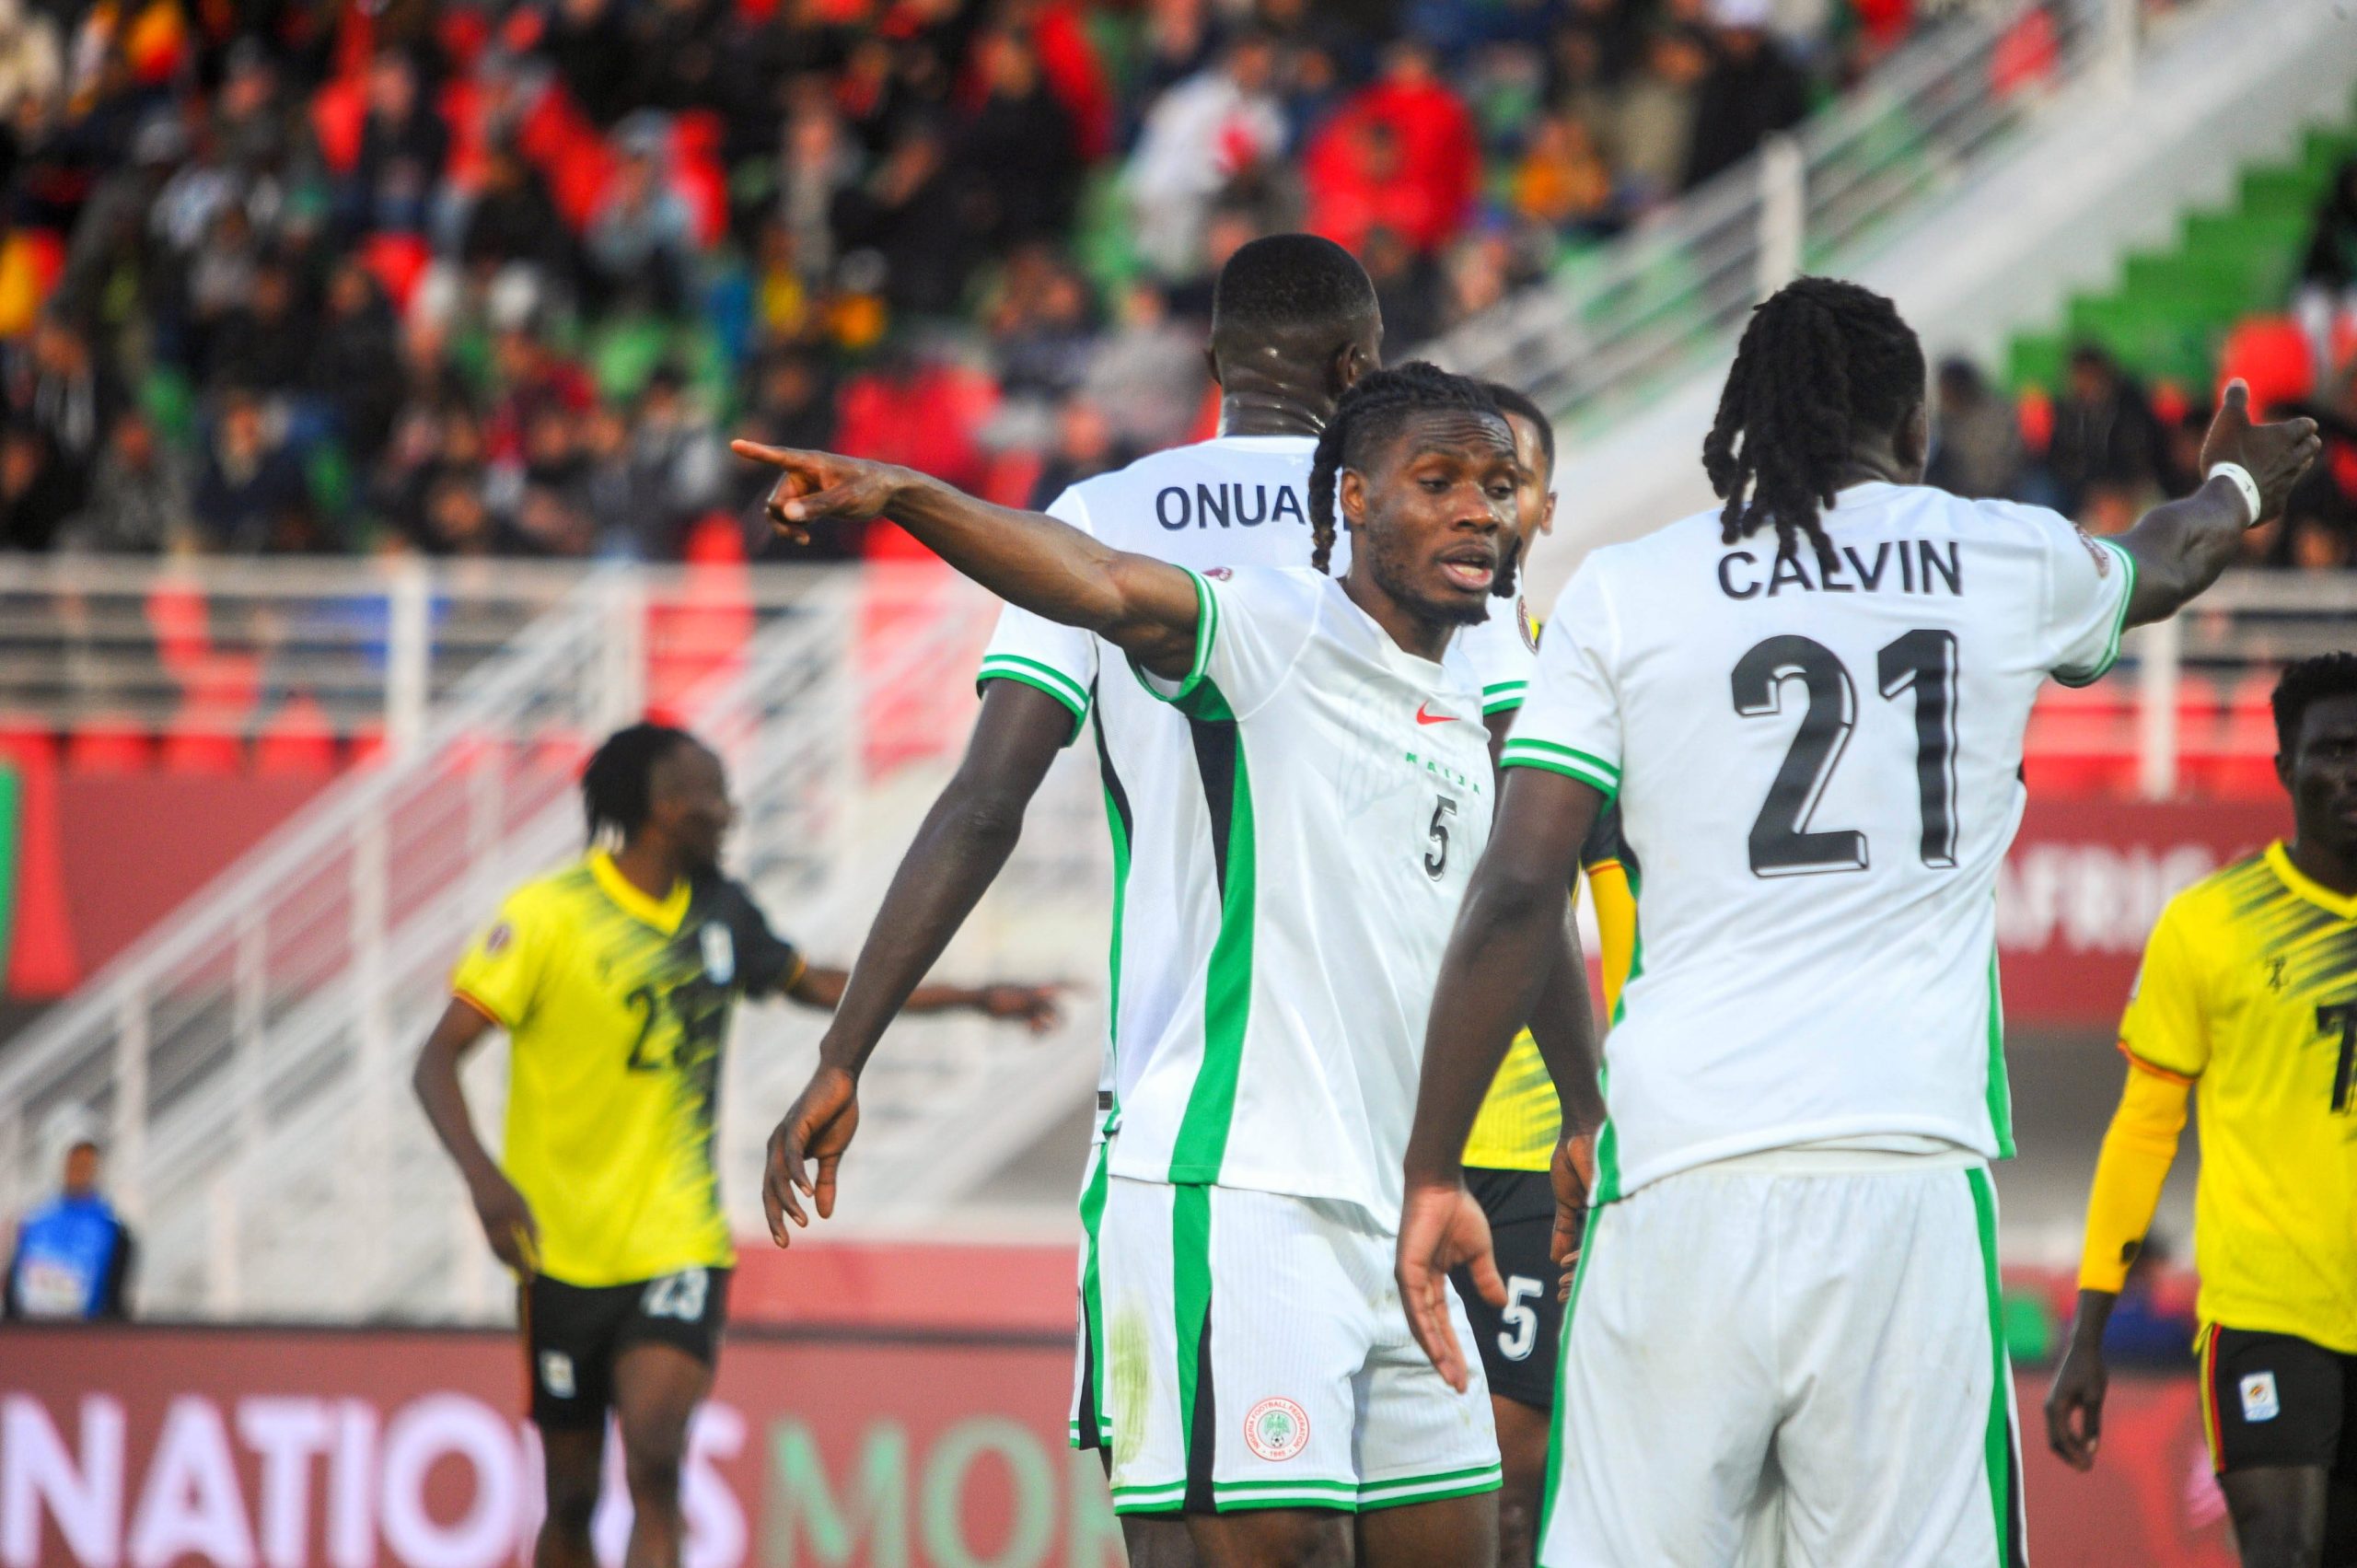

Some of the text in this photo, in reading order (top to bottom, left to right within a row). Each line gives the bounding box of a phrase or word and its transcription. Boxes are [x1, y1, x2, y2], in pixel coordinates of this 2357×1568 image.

[1156, 483, 1351, 531] ONUA
[1718, 540, 1963, 599] CALVIN
[1730, 629, 1959, 878] 21
[1424, 794, 1457, 882] 5
[1497, 1275, 1544, 1361] 5
